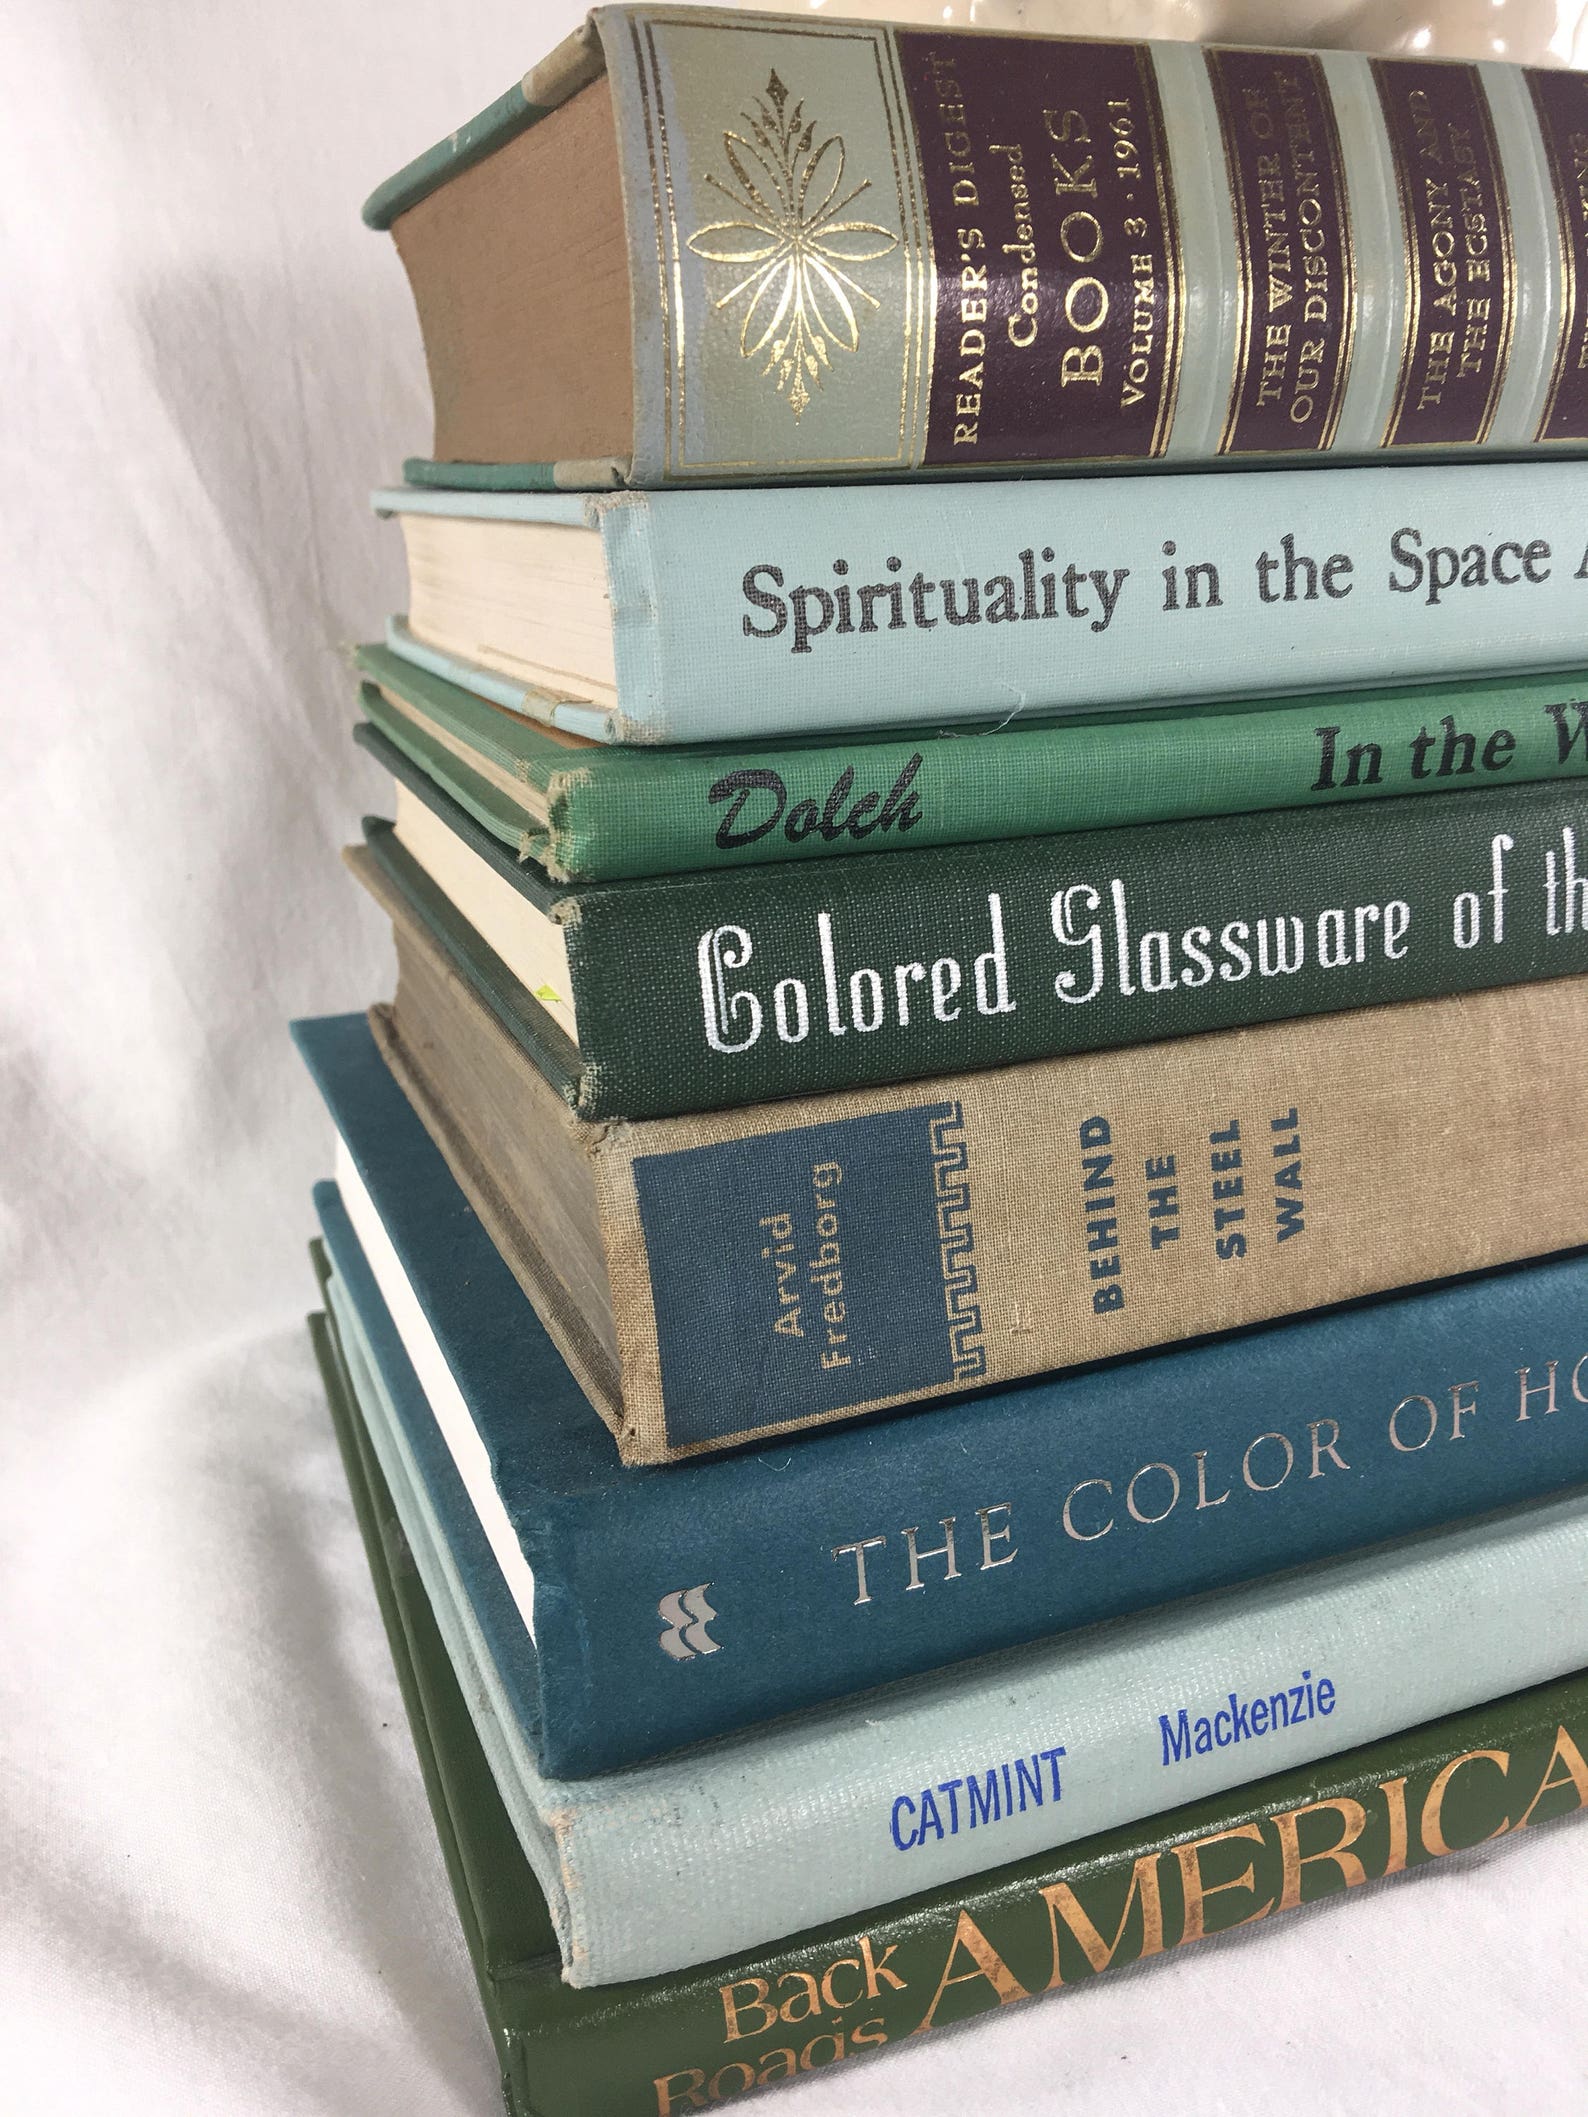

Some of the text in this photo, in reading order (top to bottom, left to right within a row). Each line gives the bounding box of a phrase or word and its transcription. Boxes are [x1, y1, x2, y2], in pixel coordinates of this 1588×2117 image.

[932, 56, 989, 446] READER'S DIGEST
[989, 143, 1038, 348] Condensed
[1042, 108, 1109, 387] BOOKS
[1108, 97, 1154, 408] VOLUME 3 1961
[1256, 152, 1293, 313] WINTER
[1273, 70, 1328, 423] OUR DISCONTENT
[1408, 89, 1458, 410] THE AGONY AND
[1447, 121, 1491, 378] THE ECSTASY
[1256, 323, 1292, 407] THE
[741, 546, 1131, 654] Spirituality
[1161, 541, 1222, 612] in
[1257, 534, 1355, 603] the
[1388, 526, 1552, 605] Space
[708, 752, 924, 851] Dolch
[1312, 725, 1383, 792] In
[1409, 714, 1516, 779] the
[697, 892, 1017, 1055] Colored
[1051, 878, 1411, 1004] Glassware
[1453, 833, 1514, 949] of
[1079, 1114, 1125, 1315] BEHIND
[1146, 1153, 1181, 1250] THE
[1210, 1118, 1248, 1261] STEEL
[1271, 1107, 1307, 1244] WALL
[759, 1212, 806, 1339] Arvid
[807, 1162, 853, 1371] Fredborg
[831, 1502, 1020, 1606] THE
[1060, 1417, 1351, 1541] COLOR
[1388, 1380, 1480, 1452] OF
[889, 1746, 1068, 1852] CATMINT
[1158, 1669, 1337, 1766] Mackenzie
[916, 1724, 1588, 2031] AMERICA
[719, 1935, 909, 2044] Back
